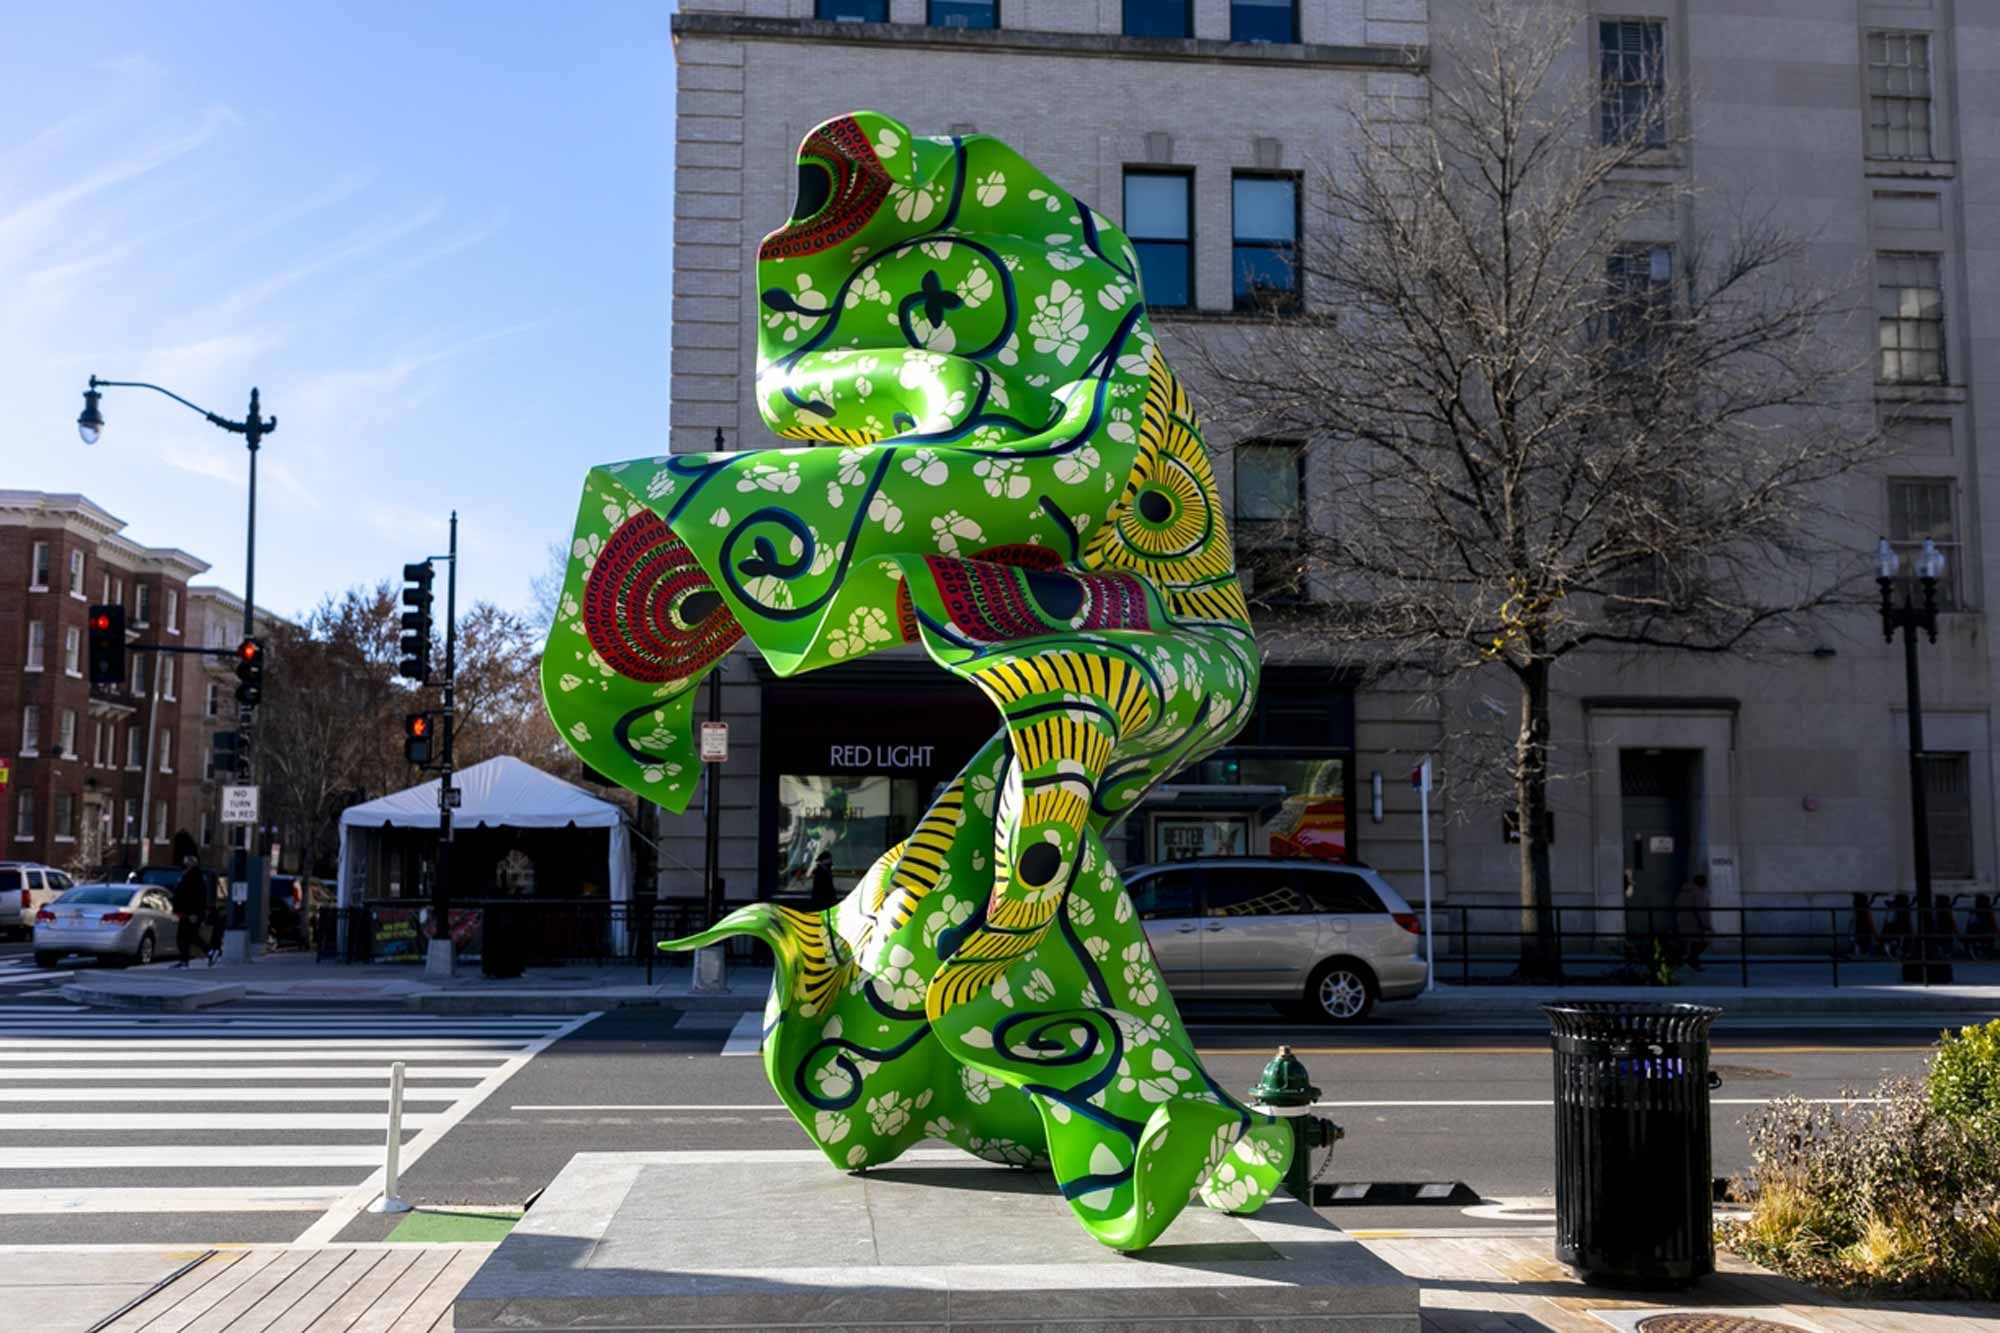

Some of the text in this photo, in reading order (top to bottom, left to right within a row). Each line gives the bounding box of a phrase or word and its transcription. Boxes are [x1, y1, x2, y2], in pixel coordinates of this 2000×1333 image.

[830, 745, 935, 767] RED LIGHT
[233, 790, 247, 798] NO
[230, 800, 251, 808] TURN
[224, 810, 256, 818] ON RED
